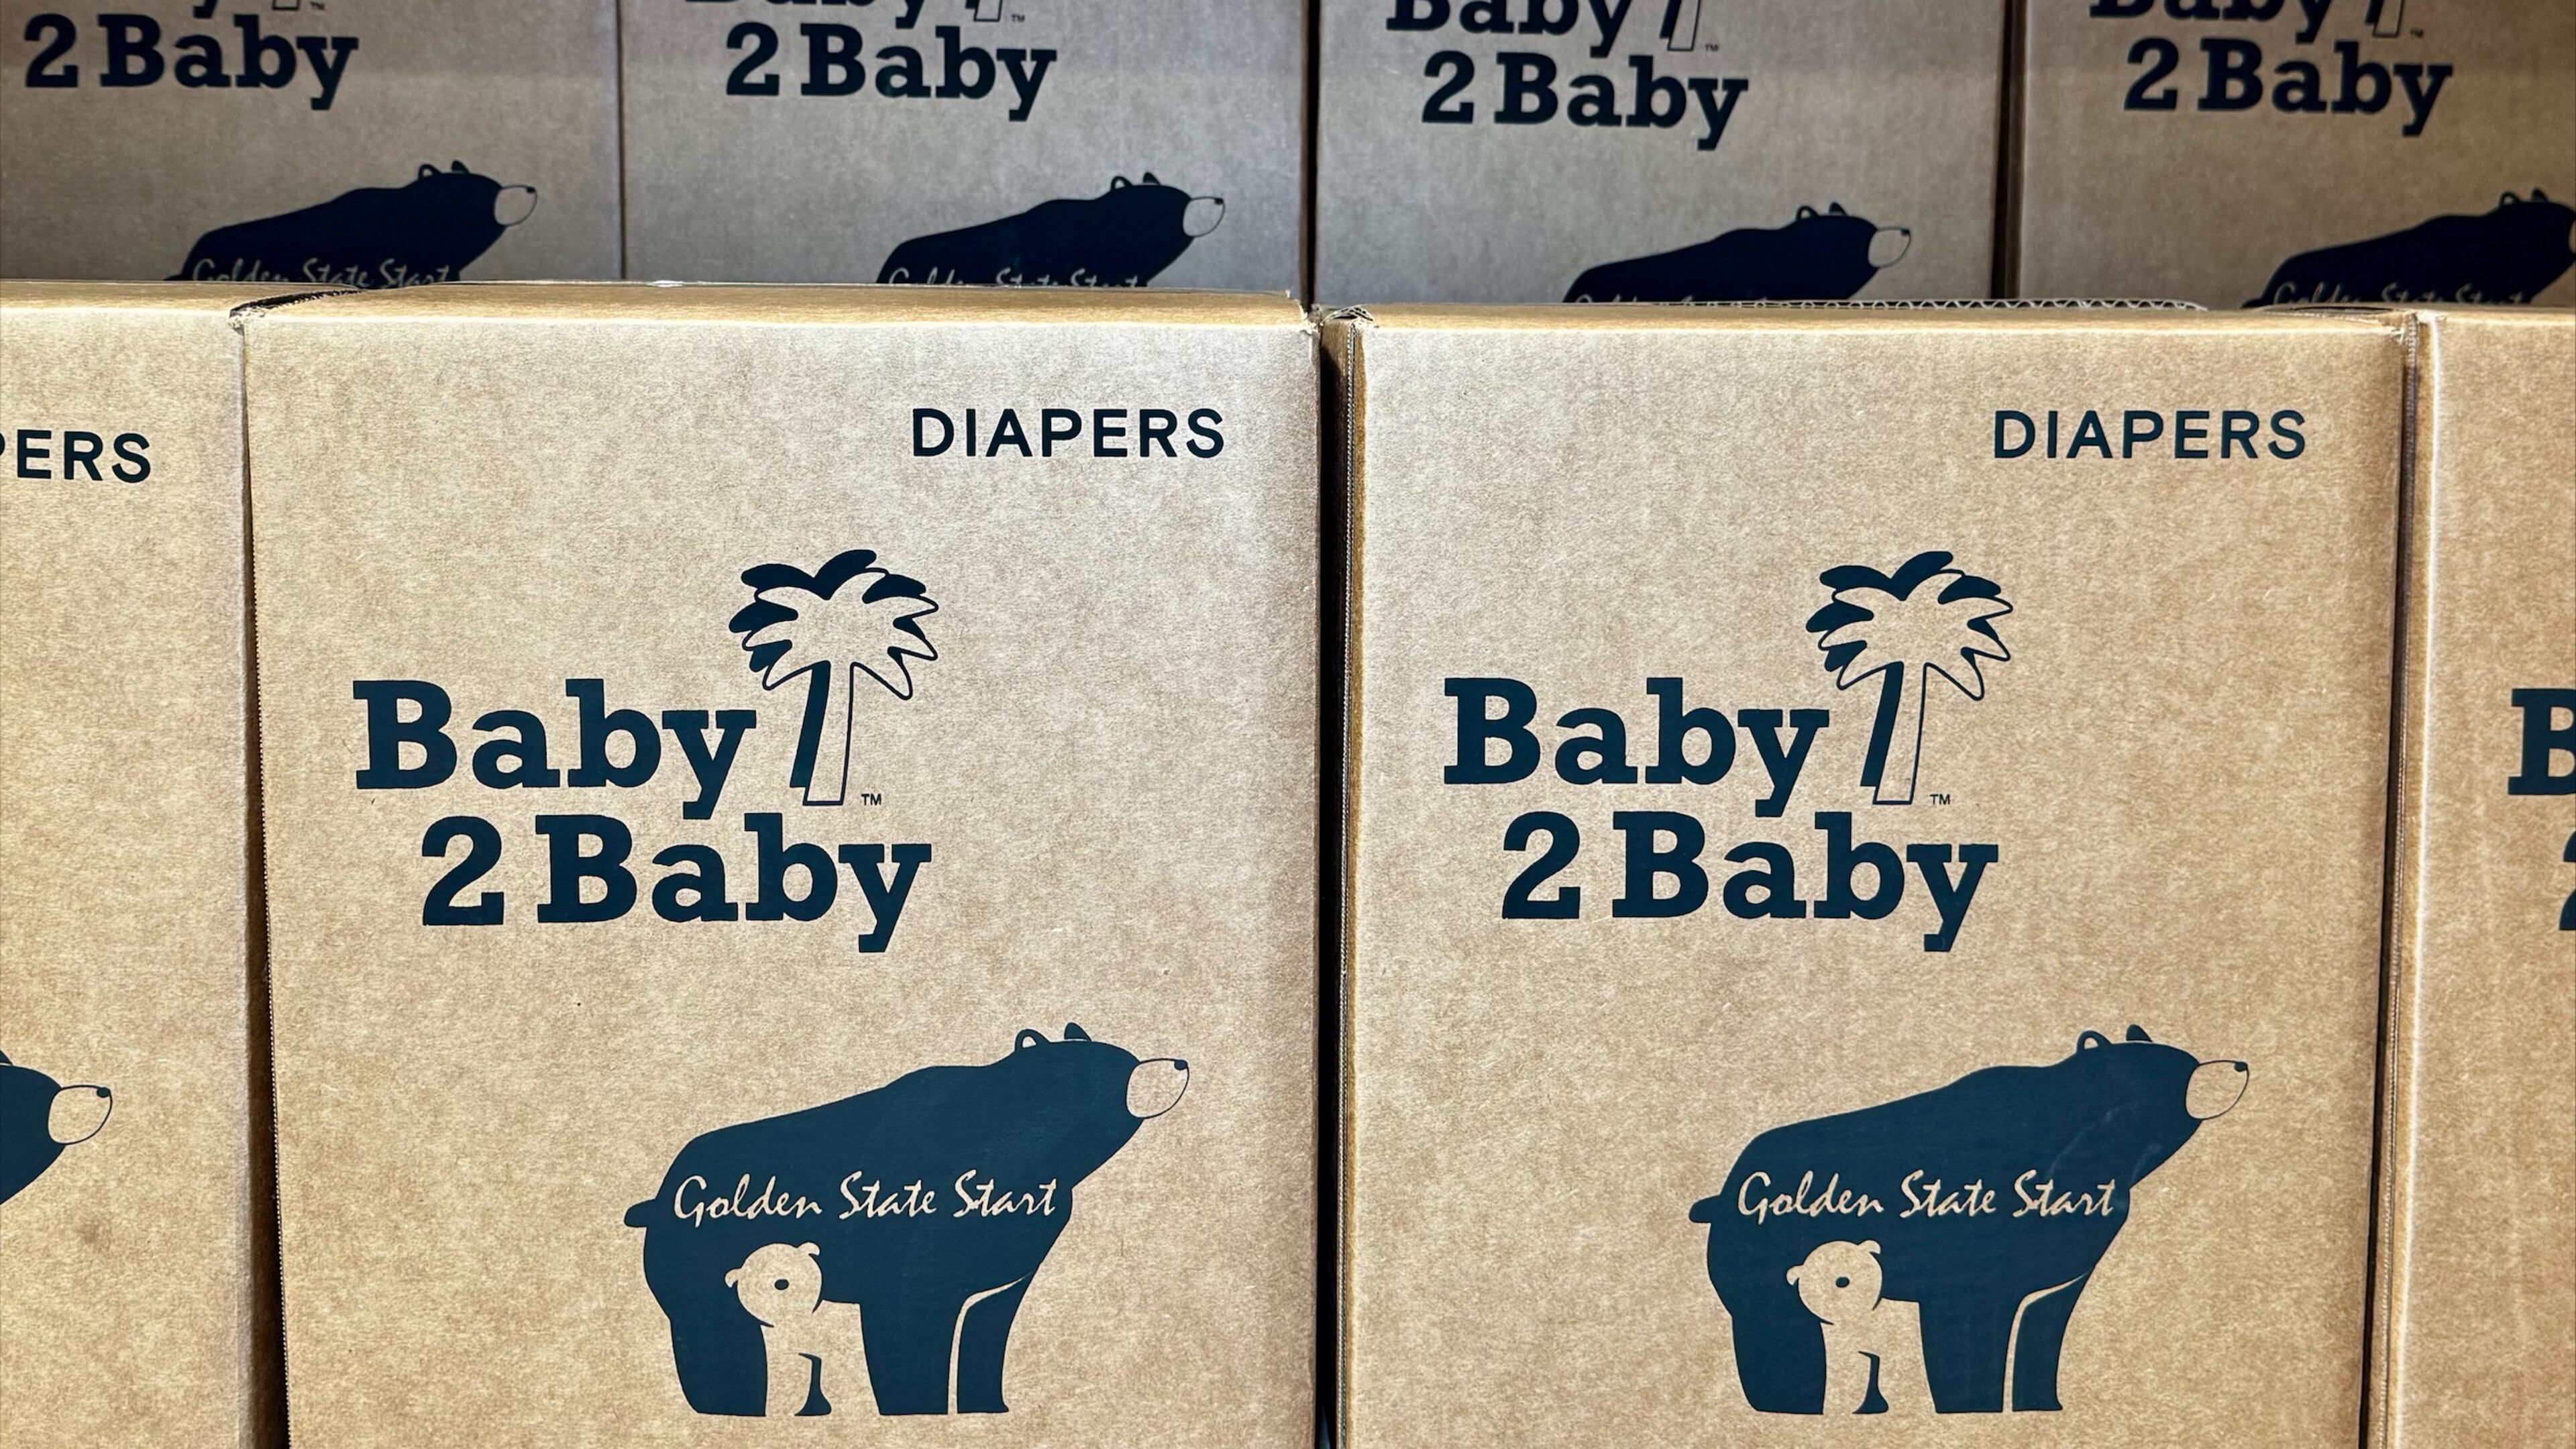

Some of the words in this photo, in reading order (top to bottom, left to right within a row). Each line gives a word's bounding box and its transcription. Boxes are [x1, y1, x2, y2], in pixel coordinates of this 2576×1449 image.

[24, 13, 78, 88] 2
[98, 14, 358, 110] Baby
[726, 21, 780, 96] 2
[800, 23, 1057, 121] Baby
[1421, 50, 1474, 123] 2
[1495, 52, 1749, 151] Baby
[2124, 37, 2179, 111] 2
[2198, 38, 2453, 137] Baby
[0, 429, 151, 484] ERS
[913, 409, 1224, 459] DIAPERS
[1994, 410, 2306, 460] DIAPERS
[353, 679, 757, 820] Baby
[1444, 678, 1830, 817] Baby
[422, 816, 504, 926] 2
[535, 812, 931, 953] Baby
[1502, 811, 1580, 919] 2
[1613, 811, 1998, 953] Baby
[674, 1174, 822, 1228] Golden
[839, 1171, 936, 1220] State
[953, 1169, 1057, 1218] Start
[1737, 1170, 1884, 1225] Golden
[1899, 1169, 1996, 1218] State
[2012, 1169, 2115, 1218] Start
